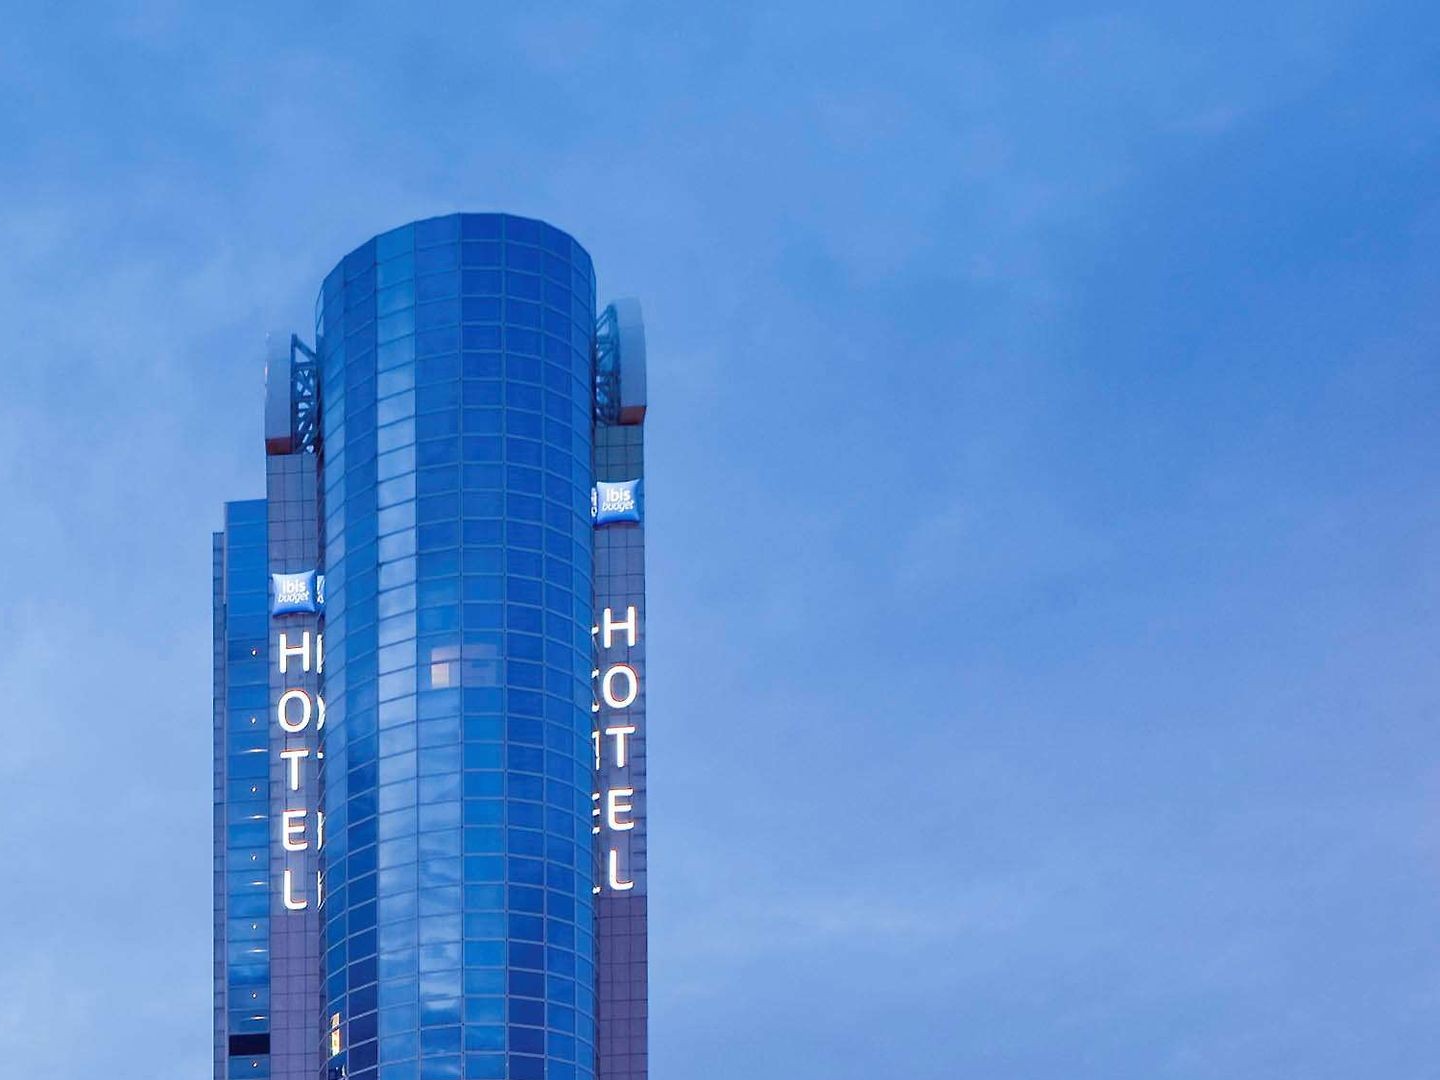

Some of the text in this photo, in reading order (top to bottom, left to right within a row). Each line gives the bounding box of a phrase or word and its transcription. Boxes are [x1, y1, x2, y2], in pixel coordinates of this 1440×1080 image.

[606, 488, 631, 502] ibis
[602, 500, 635, 512] budget
[281, 579, 307, 594] ibis
[278, 591, 310, 604] budget
[602, 606, 638, 891] HOTEL
[277, 631, 311, 911] HOTEL
